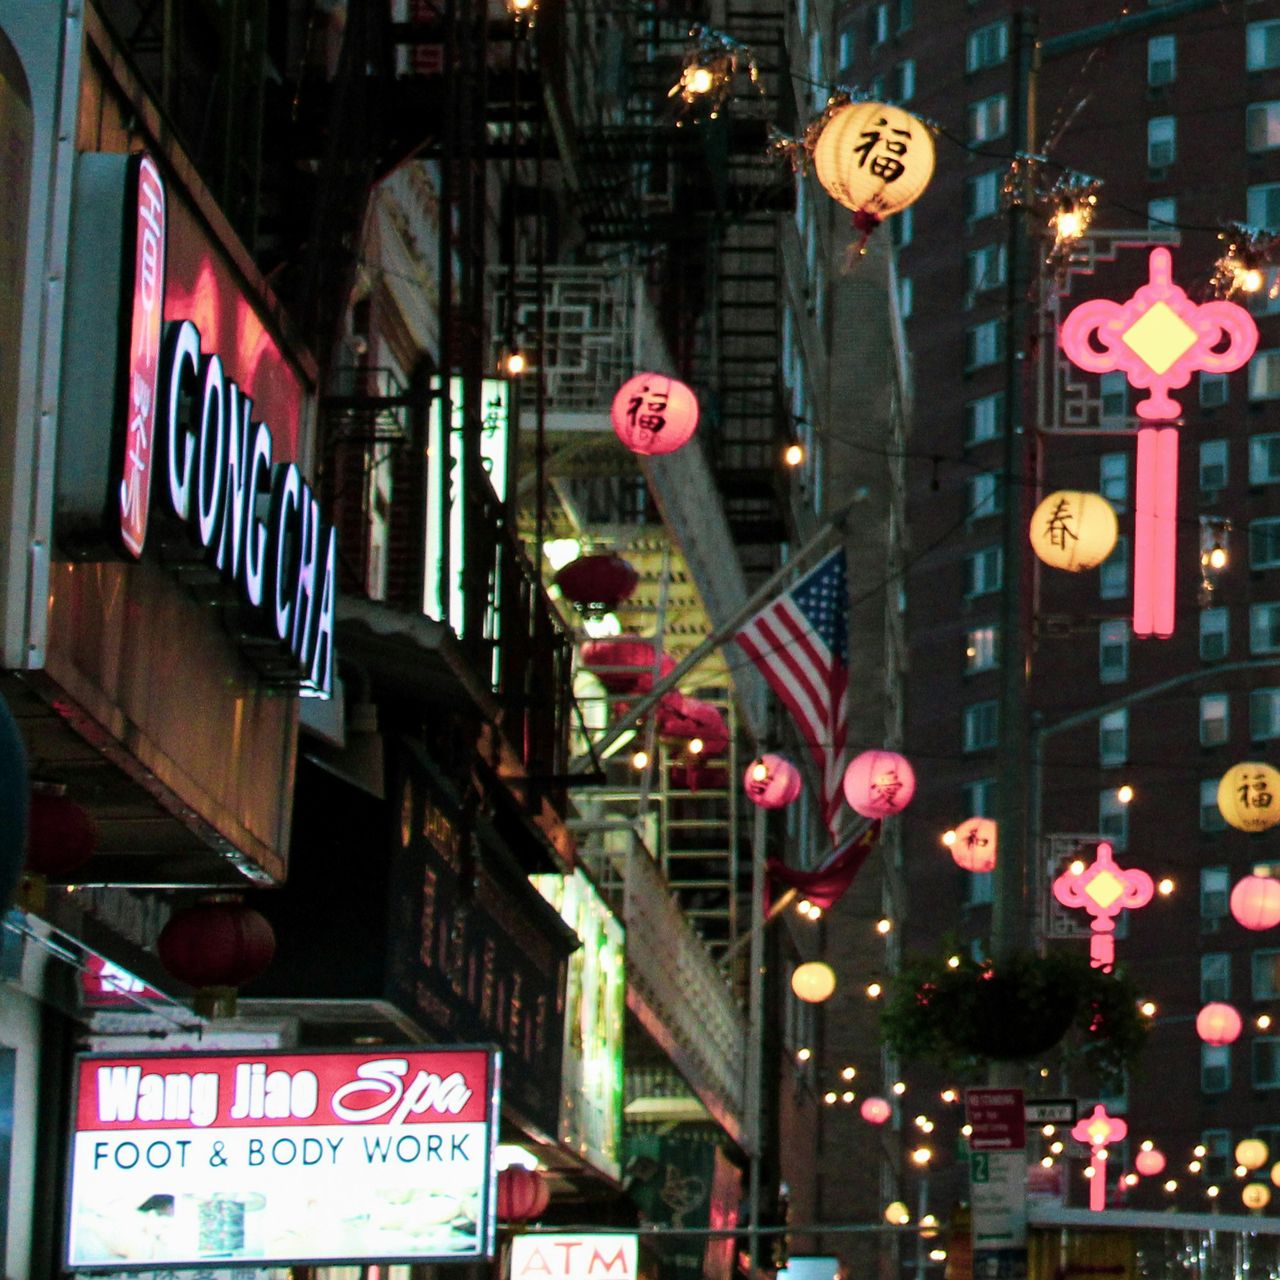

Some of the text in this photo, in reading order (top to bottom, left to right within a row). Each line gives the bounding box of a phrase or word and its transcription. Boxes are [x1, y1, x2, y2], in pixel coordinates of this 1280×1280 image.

[854, 118, 912, 182] 福
[627, 387, 668, 434] 福
[1043, 498, 1079, 550] 春
[275, 463, 336, 696] CHA
[1237, 774, 1272, 808] 福
[96, 1058, 474, 1128] Wang Jiao Spa
[94, 1133, 470, 1170] FOOT & BODY WORK
[521, 1242, 629, 1275] ATM
